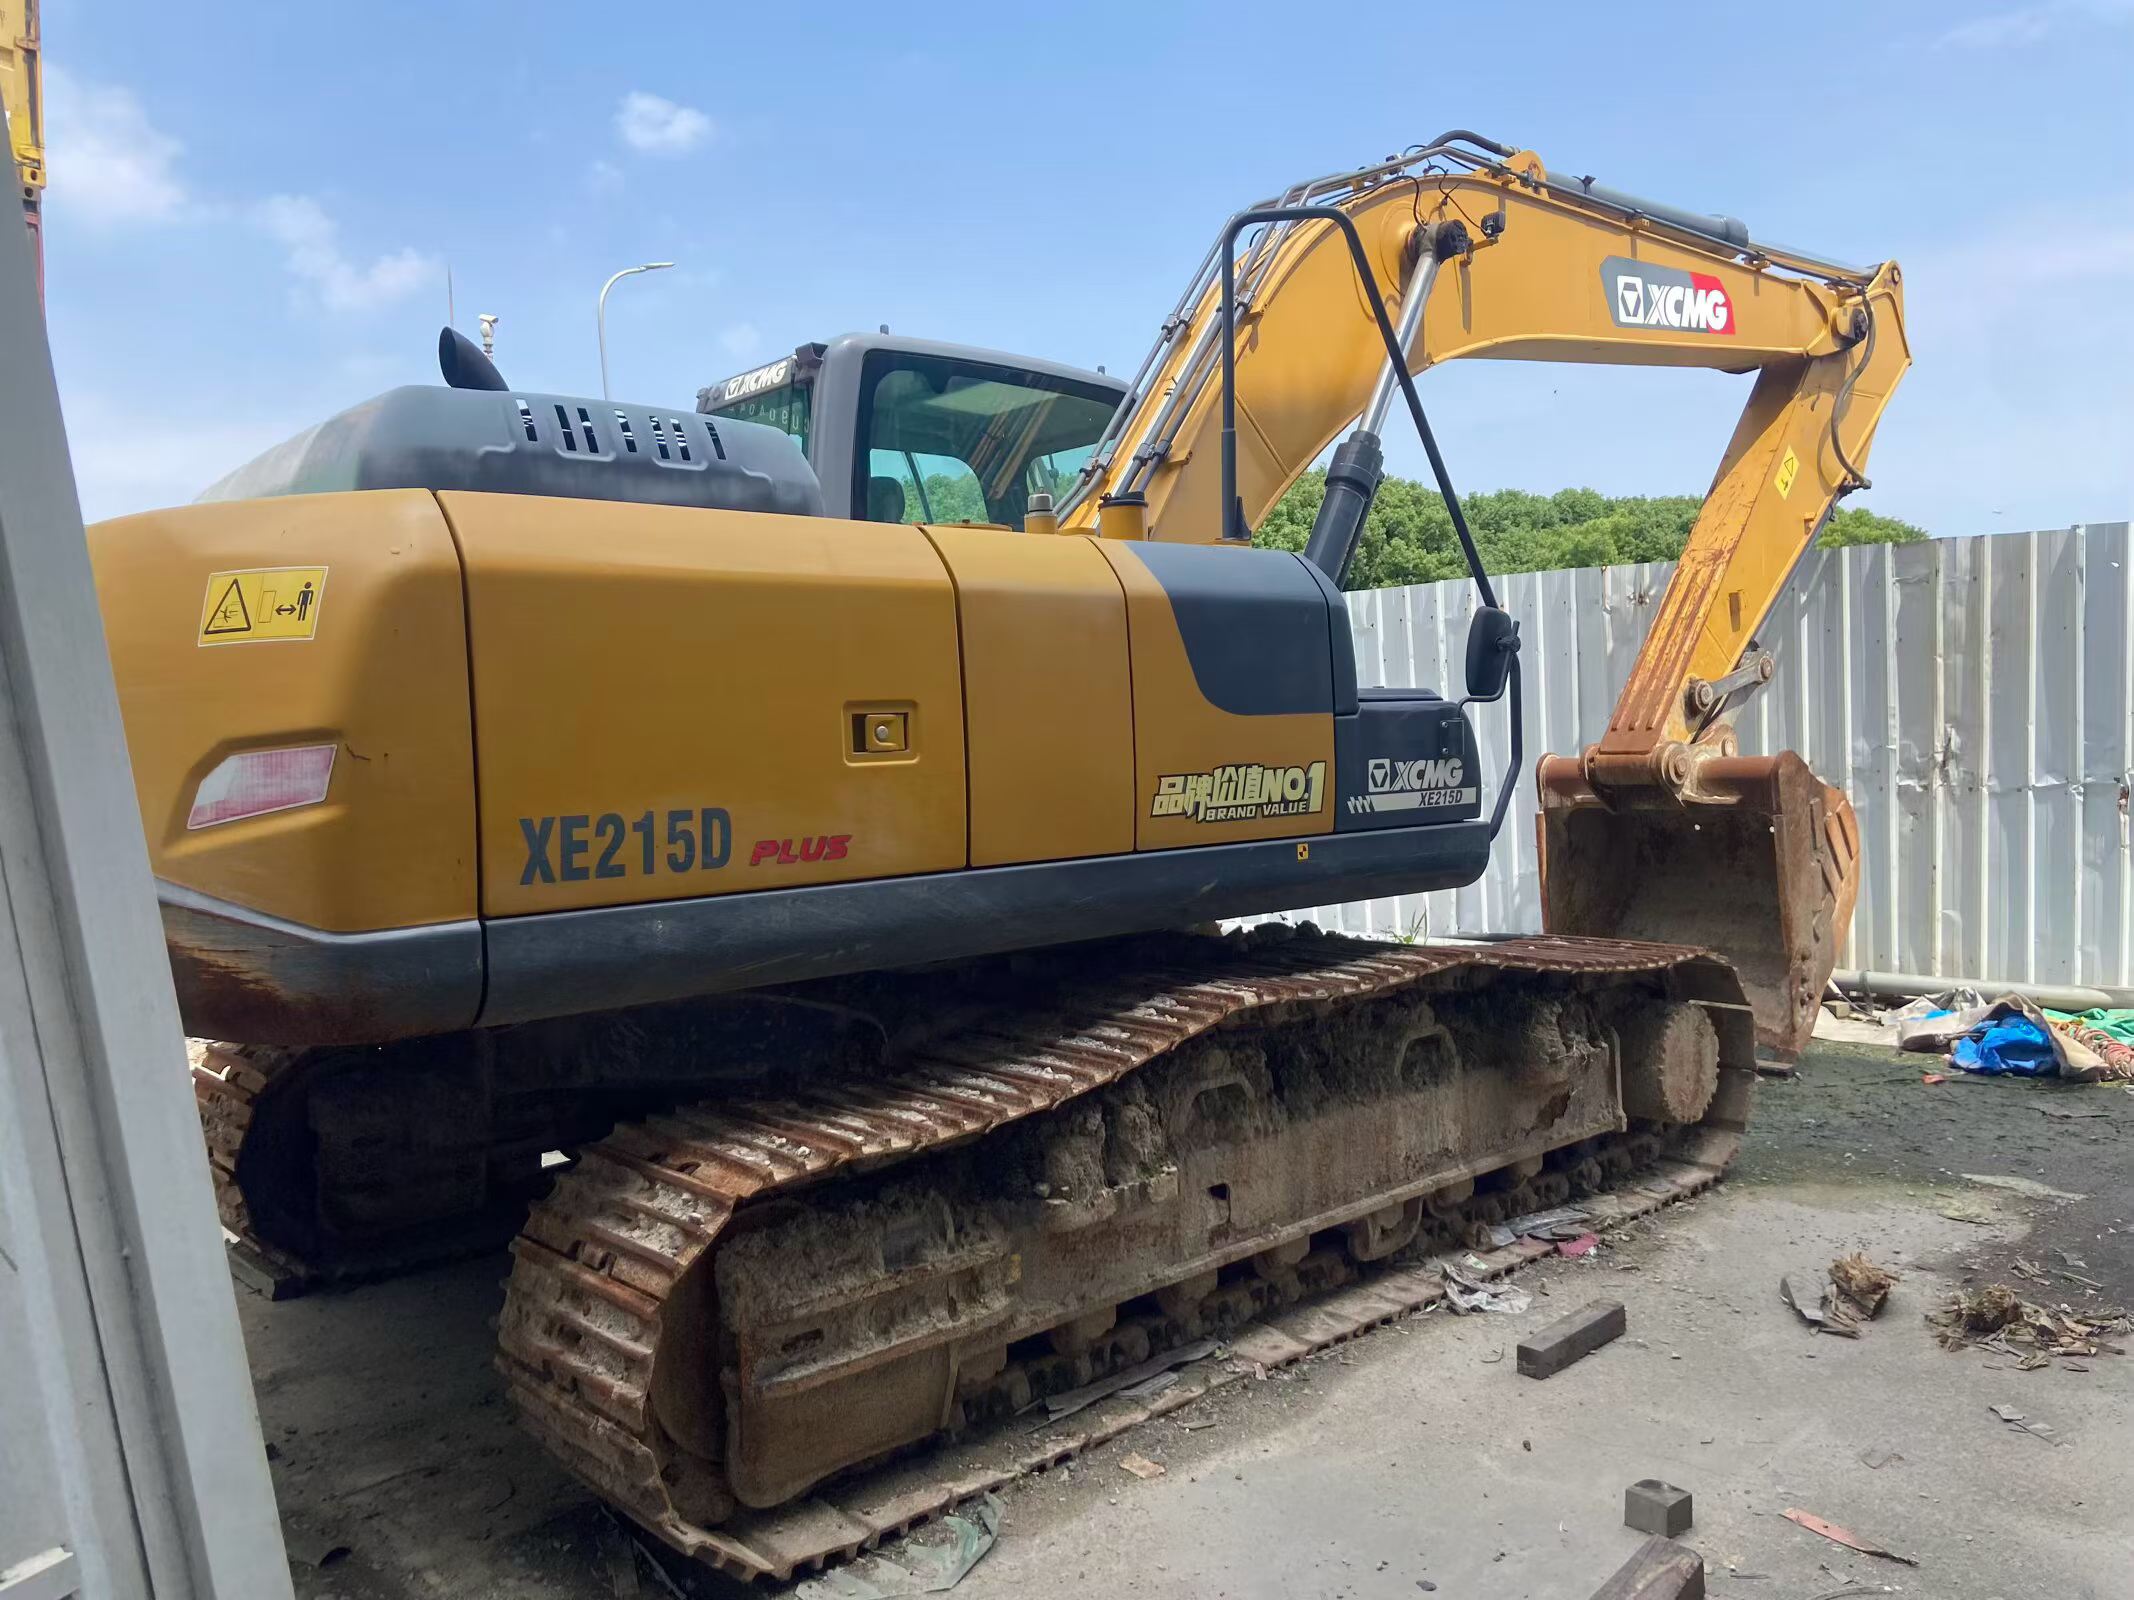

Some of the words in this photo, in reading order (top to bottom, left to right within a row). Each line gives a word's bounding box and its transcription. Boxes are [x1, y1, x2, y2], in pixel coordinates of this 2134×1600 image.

[1645, 285, 1728, 331] XCMG
[739, 360, 788, 394] XCMG
[1390, 758, 1463, 791] XCMG
[1206, 806, 1256, 820] BRAND
[1263, 801, 1306, 816] VALUE
[1419, 790, 1462, 807] XE215D
[519, 807, 732, 886] XE215D
[749, 834, 852, 866] PLUS
